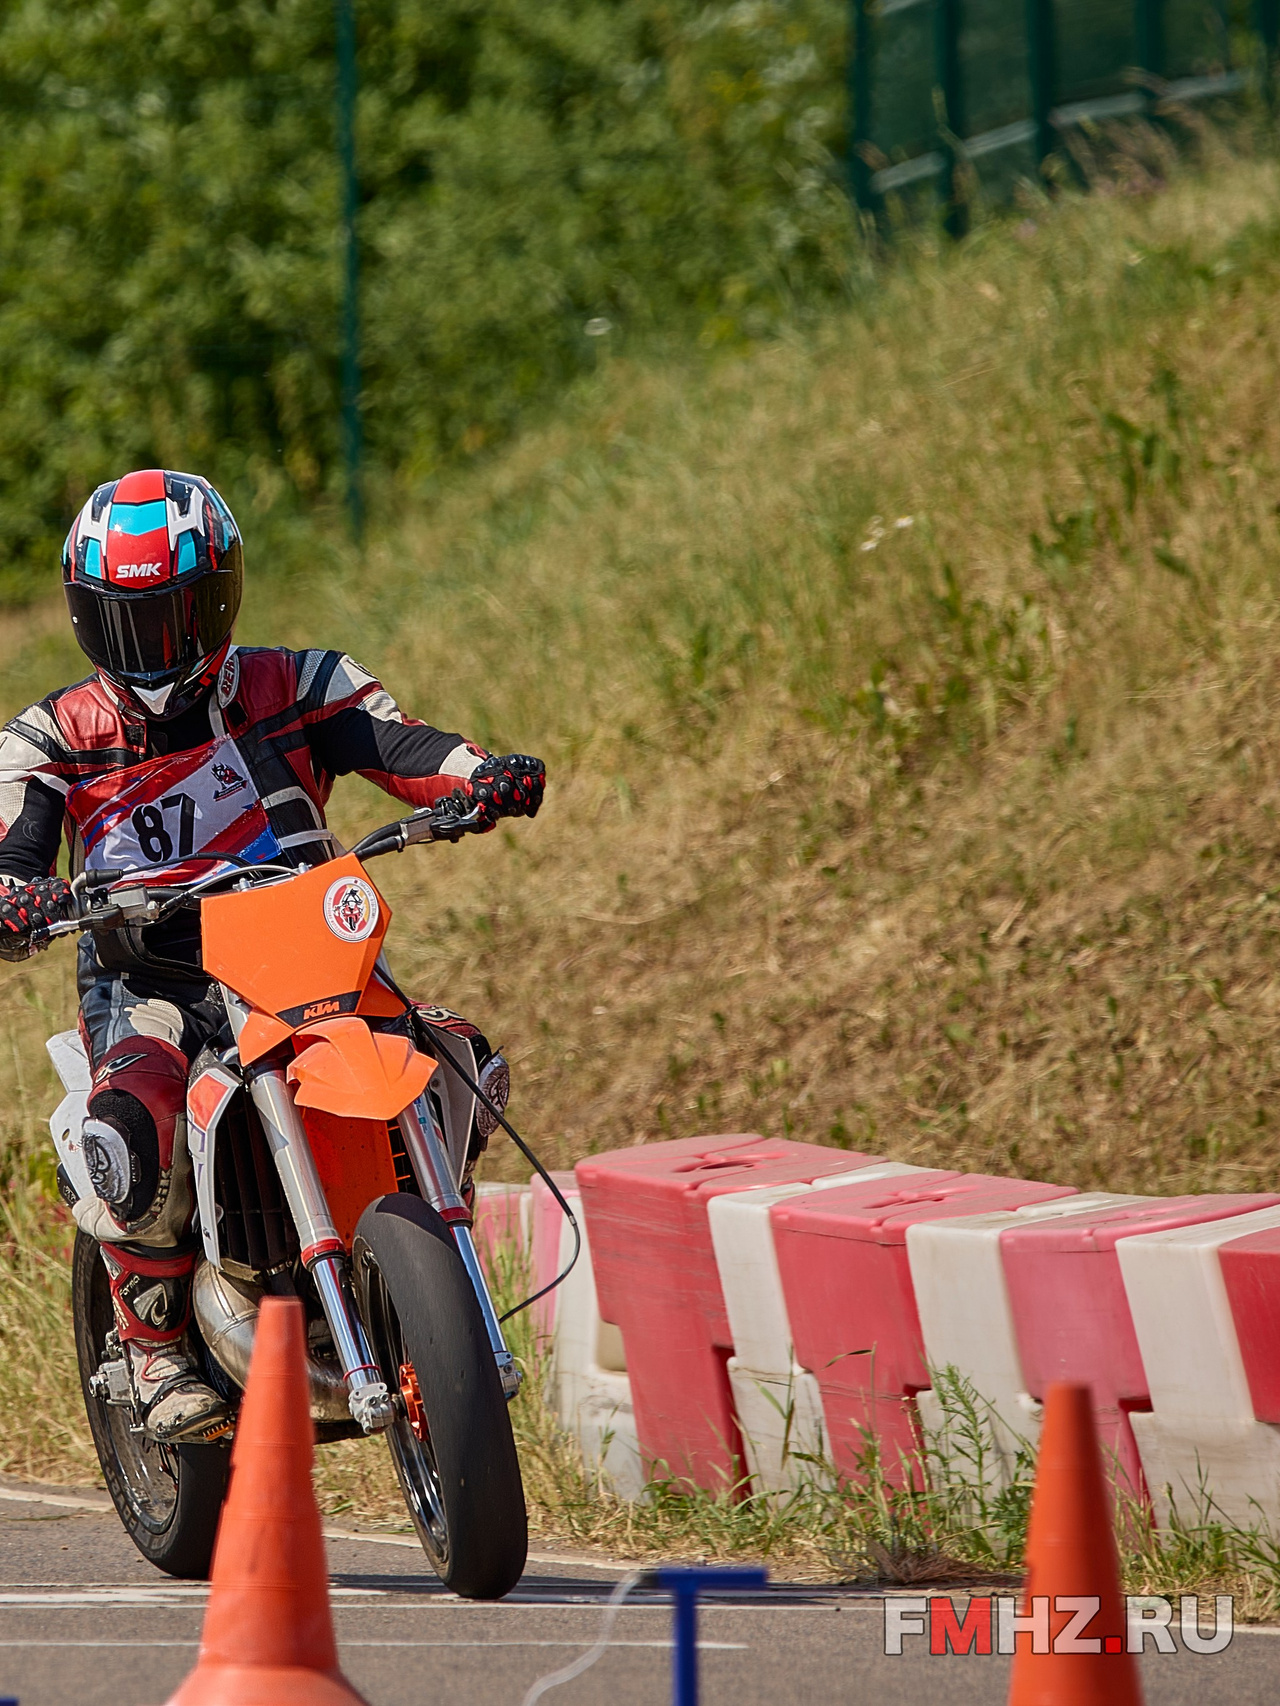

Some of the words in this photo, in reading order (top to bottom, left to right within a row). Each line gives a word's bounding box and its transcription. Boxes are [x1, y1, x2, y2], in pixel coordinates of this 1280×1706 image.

[115, 562, 162, 578] SMK
[131, 792, 196, 863] 87
[303, 1000, 340, 1020] KTM
